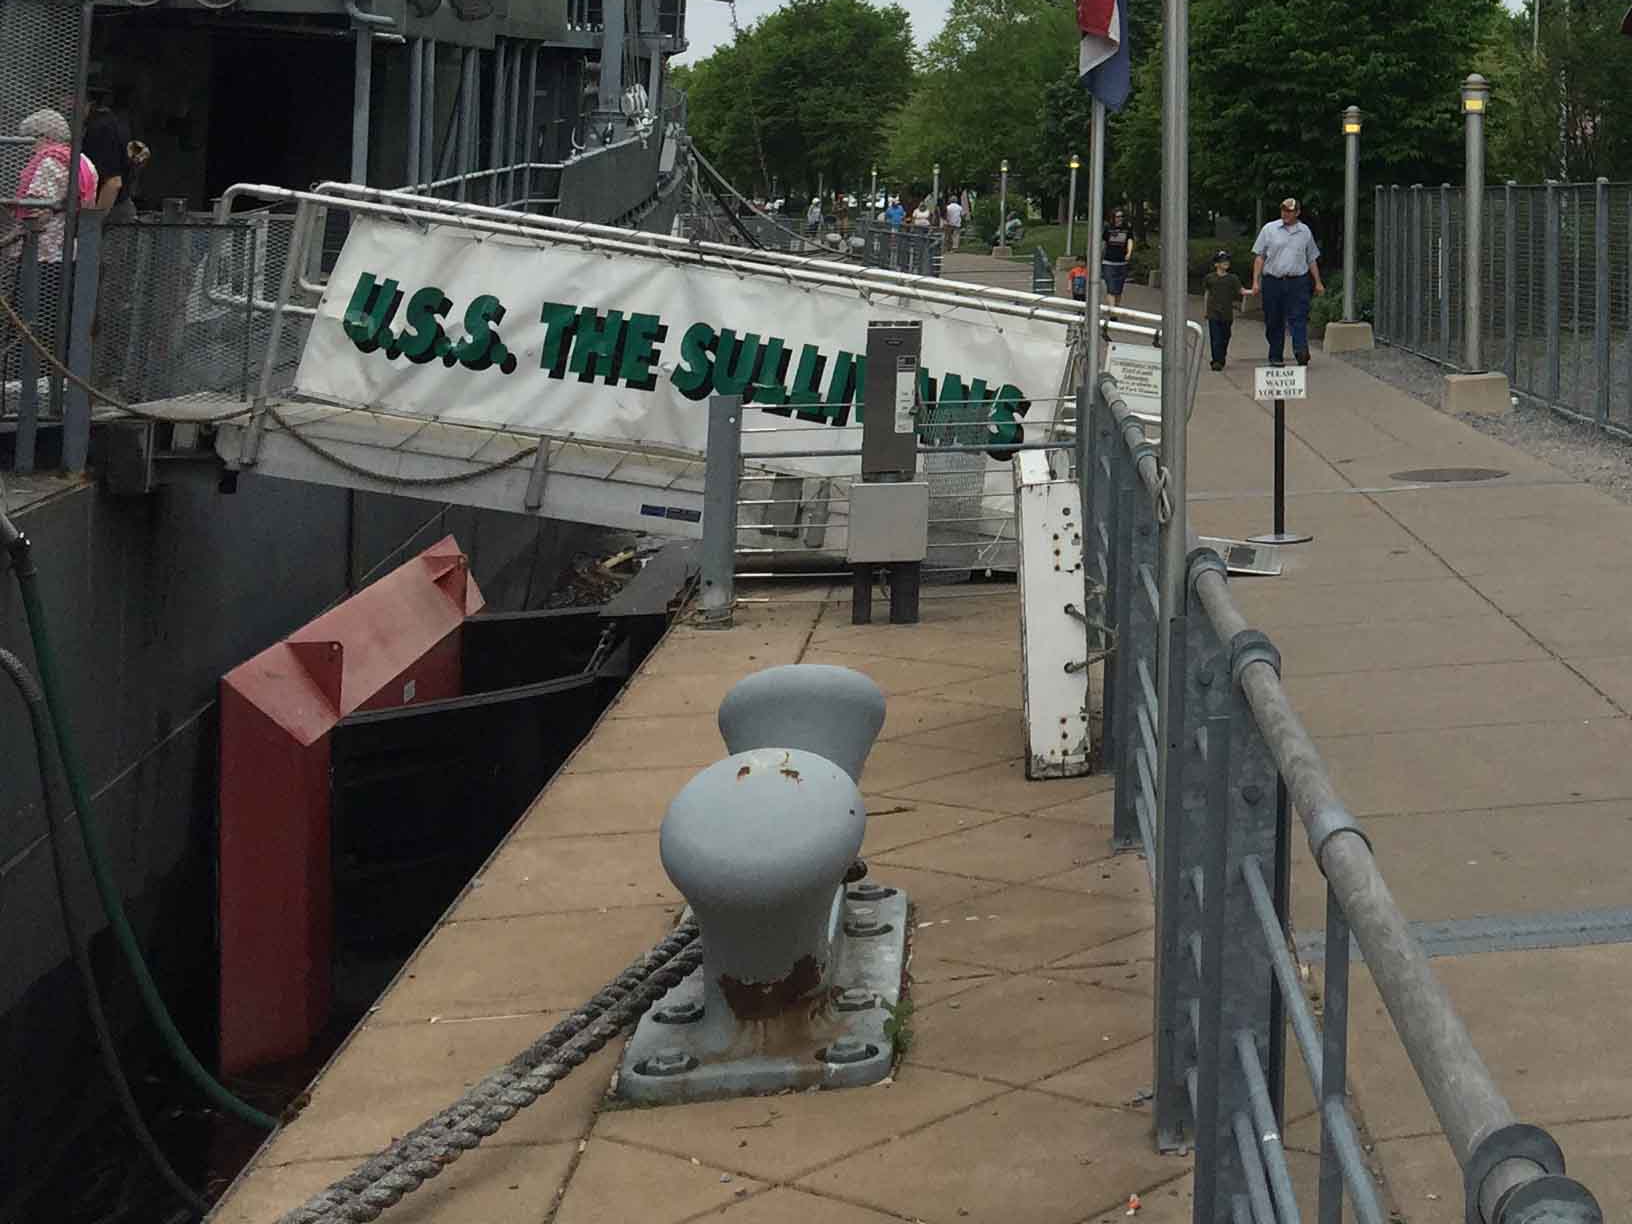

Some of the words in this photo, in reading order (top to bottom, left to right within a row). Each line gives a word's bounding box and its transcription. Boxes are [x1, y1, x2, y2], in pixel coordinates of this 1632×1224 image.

[343, 271, 517, 374] U.S.S.
[539, 302, 668, 391] THE
[671, 322, 1030, 461] SULLINS
[1265, 379, 1296, 387] WATCH
[1258, 388, 1282, 396] YOUR
[1283, 388, 1304, 396] STEP
